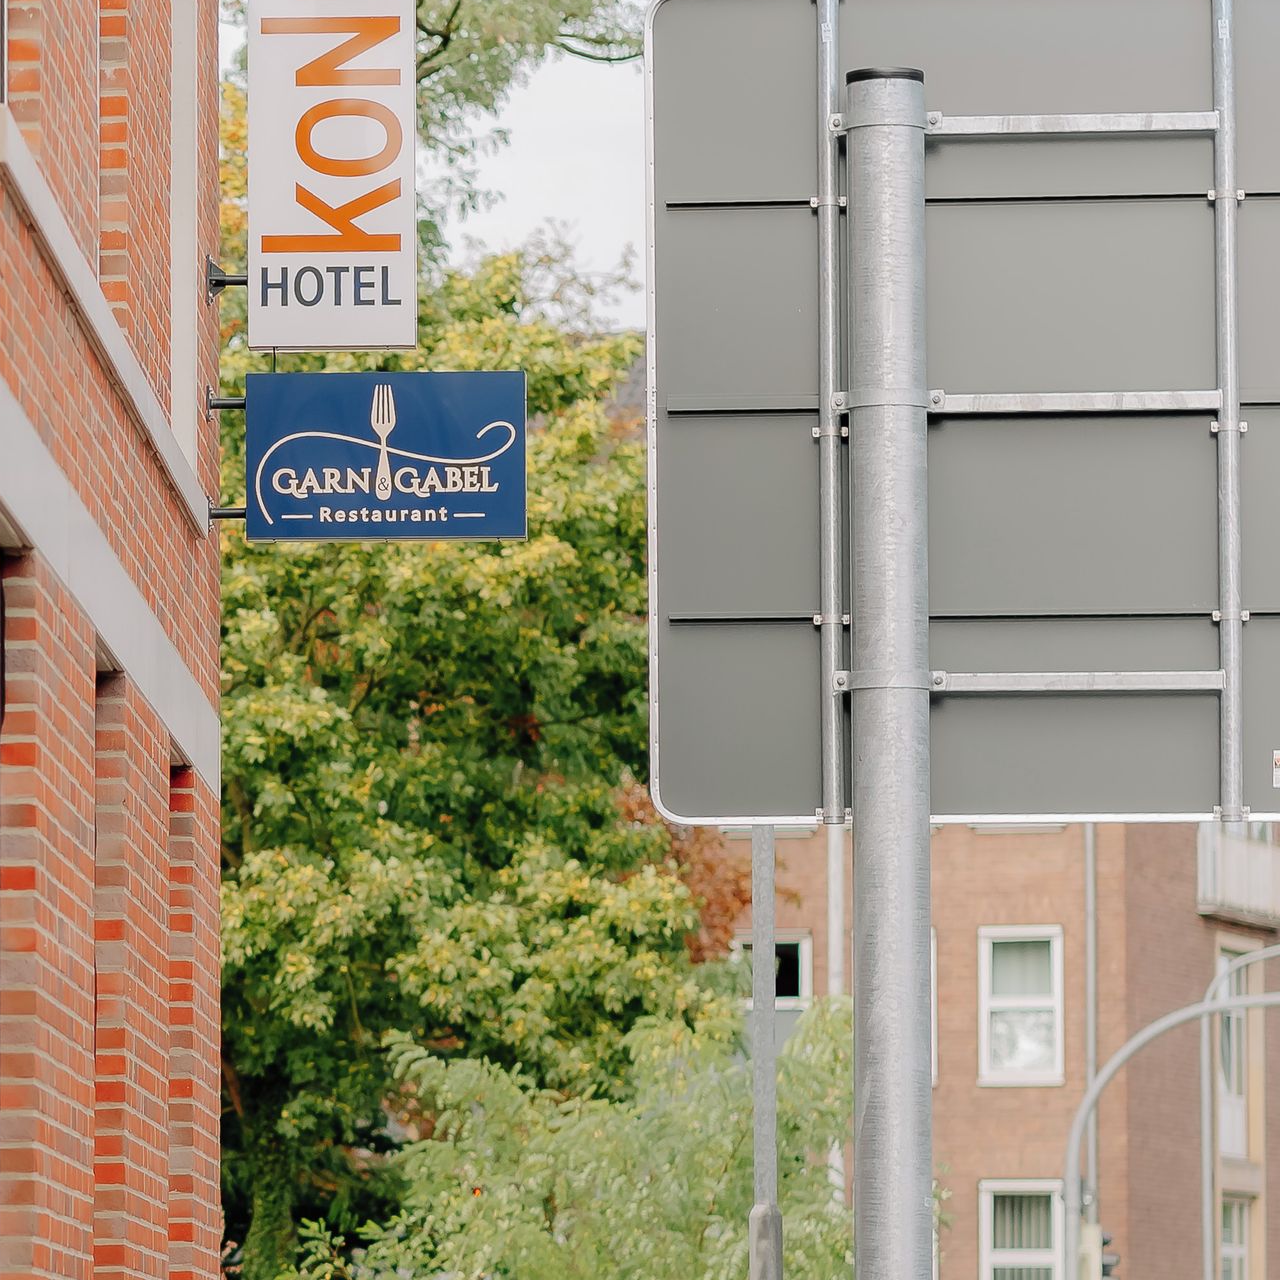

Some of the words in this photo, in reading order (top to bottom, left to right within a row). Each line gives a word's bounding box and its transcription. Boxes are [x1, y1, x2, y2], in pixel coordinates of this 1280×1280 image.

[260, 265, 402, 307] HOTEL
[272, 467, 371, 499] GARN
[377, 476, 390, 492] &
[393, 465, 499, 498] GABEL
[319, 506, 448, 523] Restaurant
